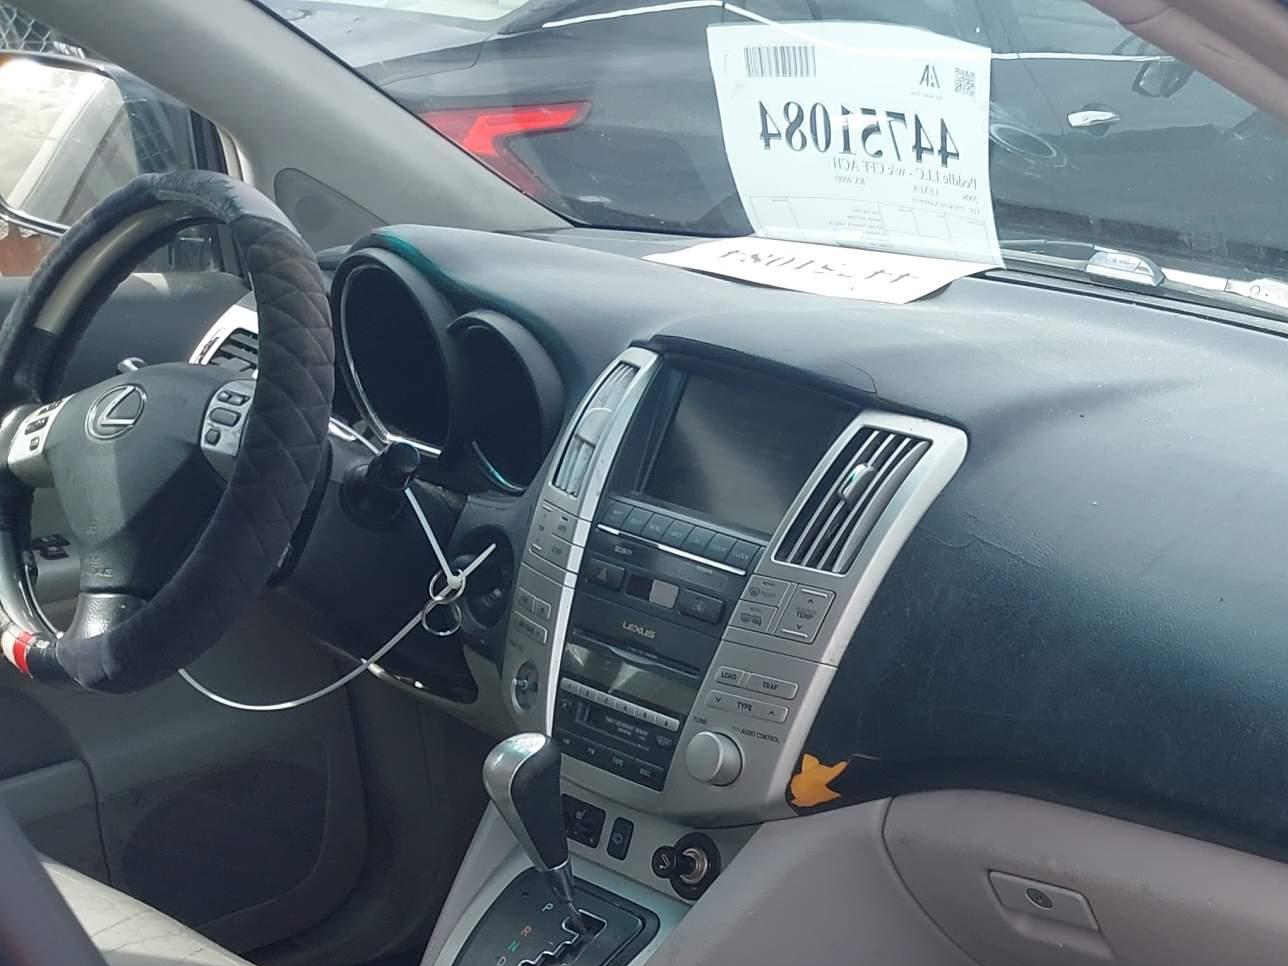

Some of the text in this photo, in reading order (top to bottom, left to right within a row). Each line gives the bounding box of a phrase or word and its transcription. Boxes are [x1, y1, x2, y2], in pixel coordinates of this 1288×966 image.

[622, 621, 657, 639] LEXUS
[721, 673, 738, 681] LOAD
[736, 701, 753, 712] TYPE
[741, 728, 756, 738] AUDIO
[756, 731, 780, 745] CONTROL
[542, 902, 554, 912] P
[520, 926, 532, 937] R
[507, 940, 520, 952] N
[496, 956, 507, 966] D
